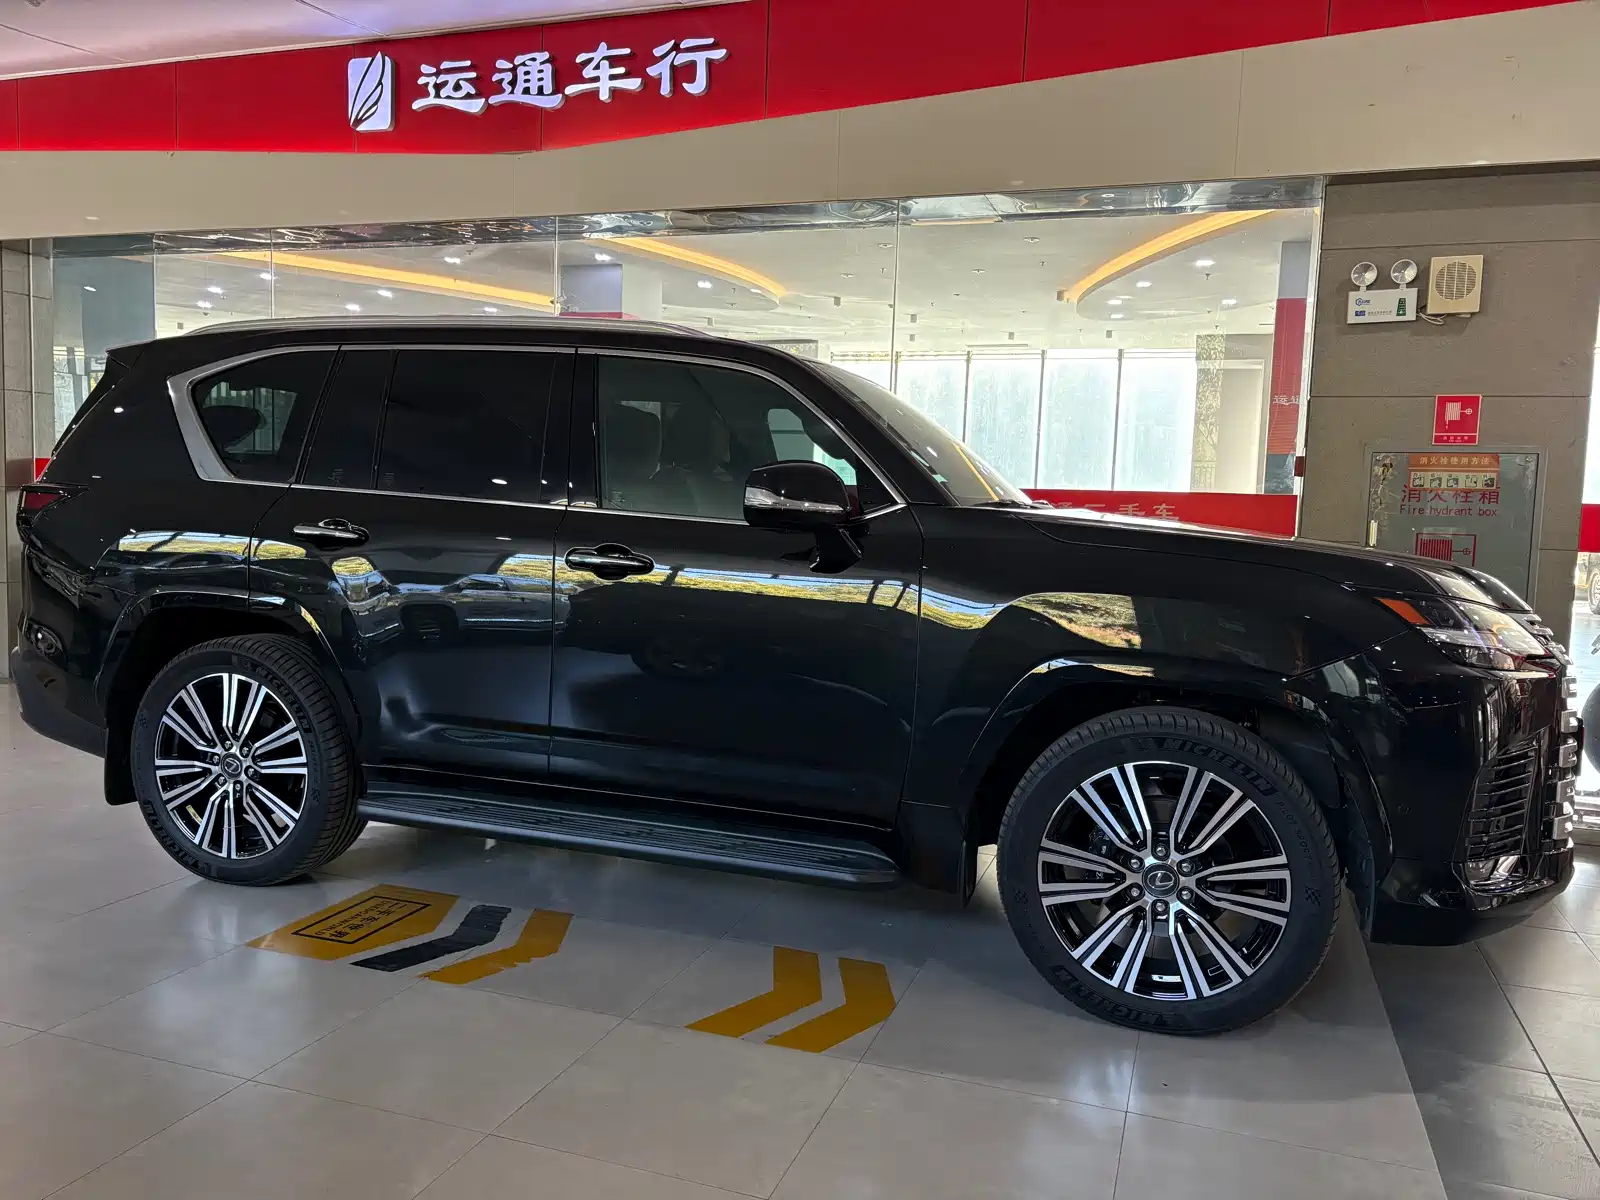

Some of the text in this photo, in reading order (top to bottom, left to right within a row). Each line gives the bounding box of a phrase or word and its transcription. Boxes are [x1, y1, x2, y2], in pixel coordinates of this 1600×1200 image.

[412, 37, 728, 115] 运通车行
[1420, 456, 1490, 465] 消火栓使用方法
[1400, 504, 1497, 516] Fire hydrant box
[254, 665, 312, 730] MICHELIN
[1164, 738, 1276, 796] MICHELIN
